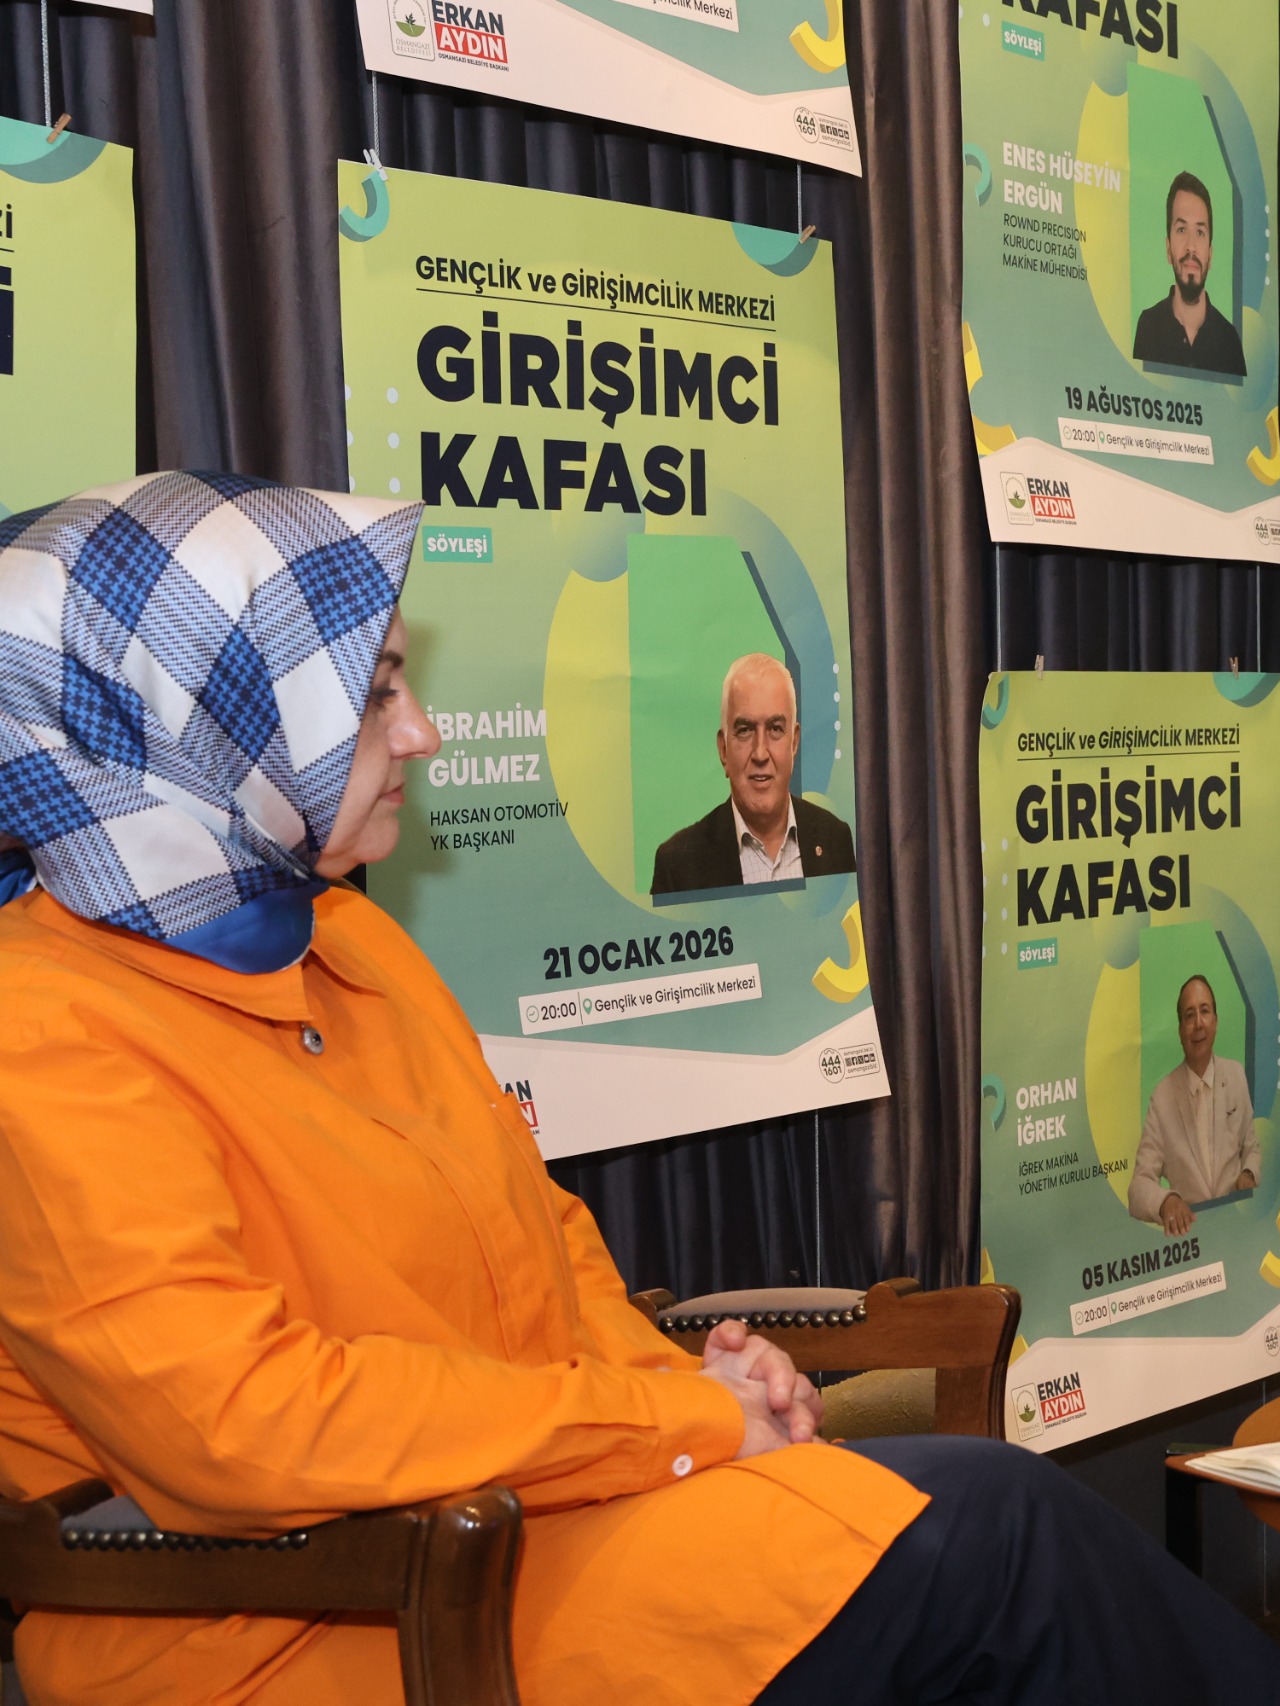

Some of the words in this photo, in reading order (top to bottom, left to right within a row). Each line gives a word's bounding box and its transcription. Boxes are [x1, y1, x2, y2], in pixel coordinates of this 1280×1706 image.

[432, 0, 504, 35] ERKAN
[694, 2, 733, 20] Merkezi
[439, 27, 504, 60] AYDIN
[1004, 30, 1042, 56] SÖYLEŞİ
[796, 114, 815, 127] 444
[798, 125, 816, 136] 1601
[1003, 141, 1046, 174] ENES
[1049, 150, 1120, 192] HÜSEYİN
[1003, 179, 1063, 214] ERGÜN
[1003, 213, 1040, 232] ROWND
[1042, 221, 1086, 242] PRECISION
[1003, 233, 1042, 253] KURUCU
[1044, 242, 1077, 260] ORTAĞI
[1003, 253, 1038, 272] MAKİNE
[1040, 260, 1088, 281] MÜHENDİSİ
[416, 255, 522, 293] GENÇLİK
[528, 272, 556, 293] ve
[562, 268, 693, 309] GİRİŞİMCİLİK
[698, 290, 775, 321] MERKEZİ
[416, 310, 779, 429] GİRİŞİMCİ
[1065, 386, 1082, 410] 19
[1087, 385, 1164, 421] AĞUSTOS
[1166, 401, 1203, 426] 2025
[1072, 428, 1095, 443] 20:00
[1106, 434, 1134, 449] Gençlik
[1135, 440, 1144, 448] ve
[1145, 439, 1183, 453] Girişimcilik
[1184, 444, 1210, 456] Merkezi
[420, 431, 706, 516] KAFASI
[1027, 477, 1071, 498] ERKAN
[1034, 497, 1074, 517] AYDIN
[427, 533, 487, 558] SÖYLEŞİ
[1017, 727, 1076, 757] GENÇLİK
[1079, 735, 1096, 750] ve
[1098, 724, 1182, 754] GİRİŞİMCİLİK
[1185, 723, 1240, 746] MERKEZİ
[428, 750, 540, 787] GÜLMEZ
[430, 807, 490, 826] HAKSAN
[494, 799, 568, 821] OTOMOTİV
[1016, 762, 1241, 848] GİRİŞİMCİ
[430, 835, 449, 850] YK
[453, 829, 514, 852] BAŞKANI
[1017, 854, 1191, 927] KAFASI
[544, 947, 572, 980] 21
[578, 936, 664, 974] OCAK
[669, 926, 733, 962] 2026
[1020, 943, 1055, 963] SÖYLEŞİ
[541, 1001, 577, 1021] 20:00
[594, 994, 637, 1016] Gençlik
[639, 994, 652, 1005] ve
[655, 982, 715, 1004] Girişimcilik
[717, 975, 756, 994] Merkezi
[822, 1055, 841, 1067] 444
[824, 1065, 842, 1076] 1601
[1016, 1077, 1077, 1110] ORHAN
[1017, 1114, 1067, 1146] İĞREK
[1018, 1159, 1044, 1177] İĞREK
[1046, 1151, 1079, 1170] MAKİNA
[1019, 1175, 1058, 1195] YÖNETİM
[1059, 1167, 1091, 1187] KURULU
[1092, 1158, 1128, 1178] BAŞKANI
[1082, 1263, 1104, 1290] 05
[1107, 1249, 1161, 1284] KASIM
[1163, 1237, 1200, 1268] 2025
[1084, 1306, 1107, 1323] 20:00
[1118, 1296, 1145, 1312] Gençlik
[1146, 1294, 1155, 1303] ve
[1156, 1281, 1195, 1301] Girişimcilik
[1195, 1272, 1222, 1289] Merkezi
[1037, 1371, 1081, 1401] ERKAN
[1044, 1391, 1084, 1421] AYDIN
